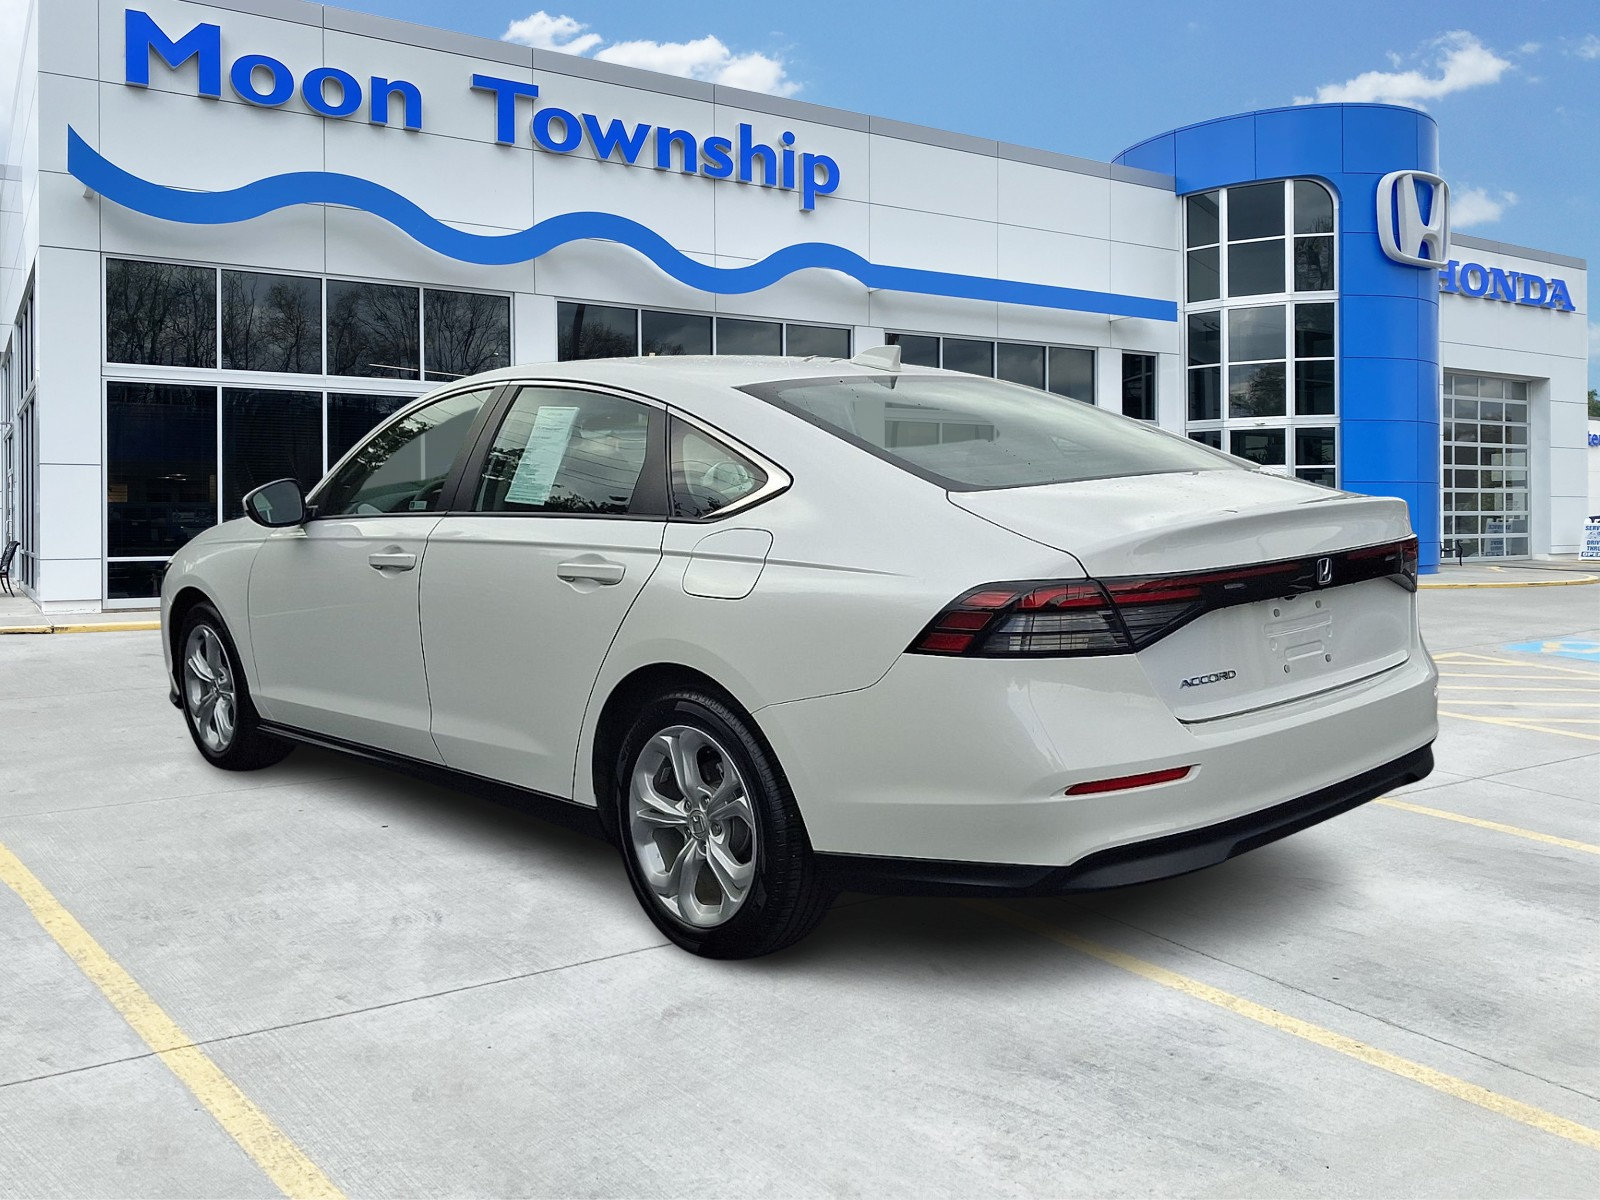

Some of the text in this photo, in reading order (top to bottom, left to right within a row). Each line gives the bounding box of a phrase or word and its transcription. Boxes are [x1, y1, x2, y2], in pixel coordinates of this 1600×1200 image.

[124, 8, 841, 213] Moon Township
[1179, 669, 1237, 689] ACCORD
